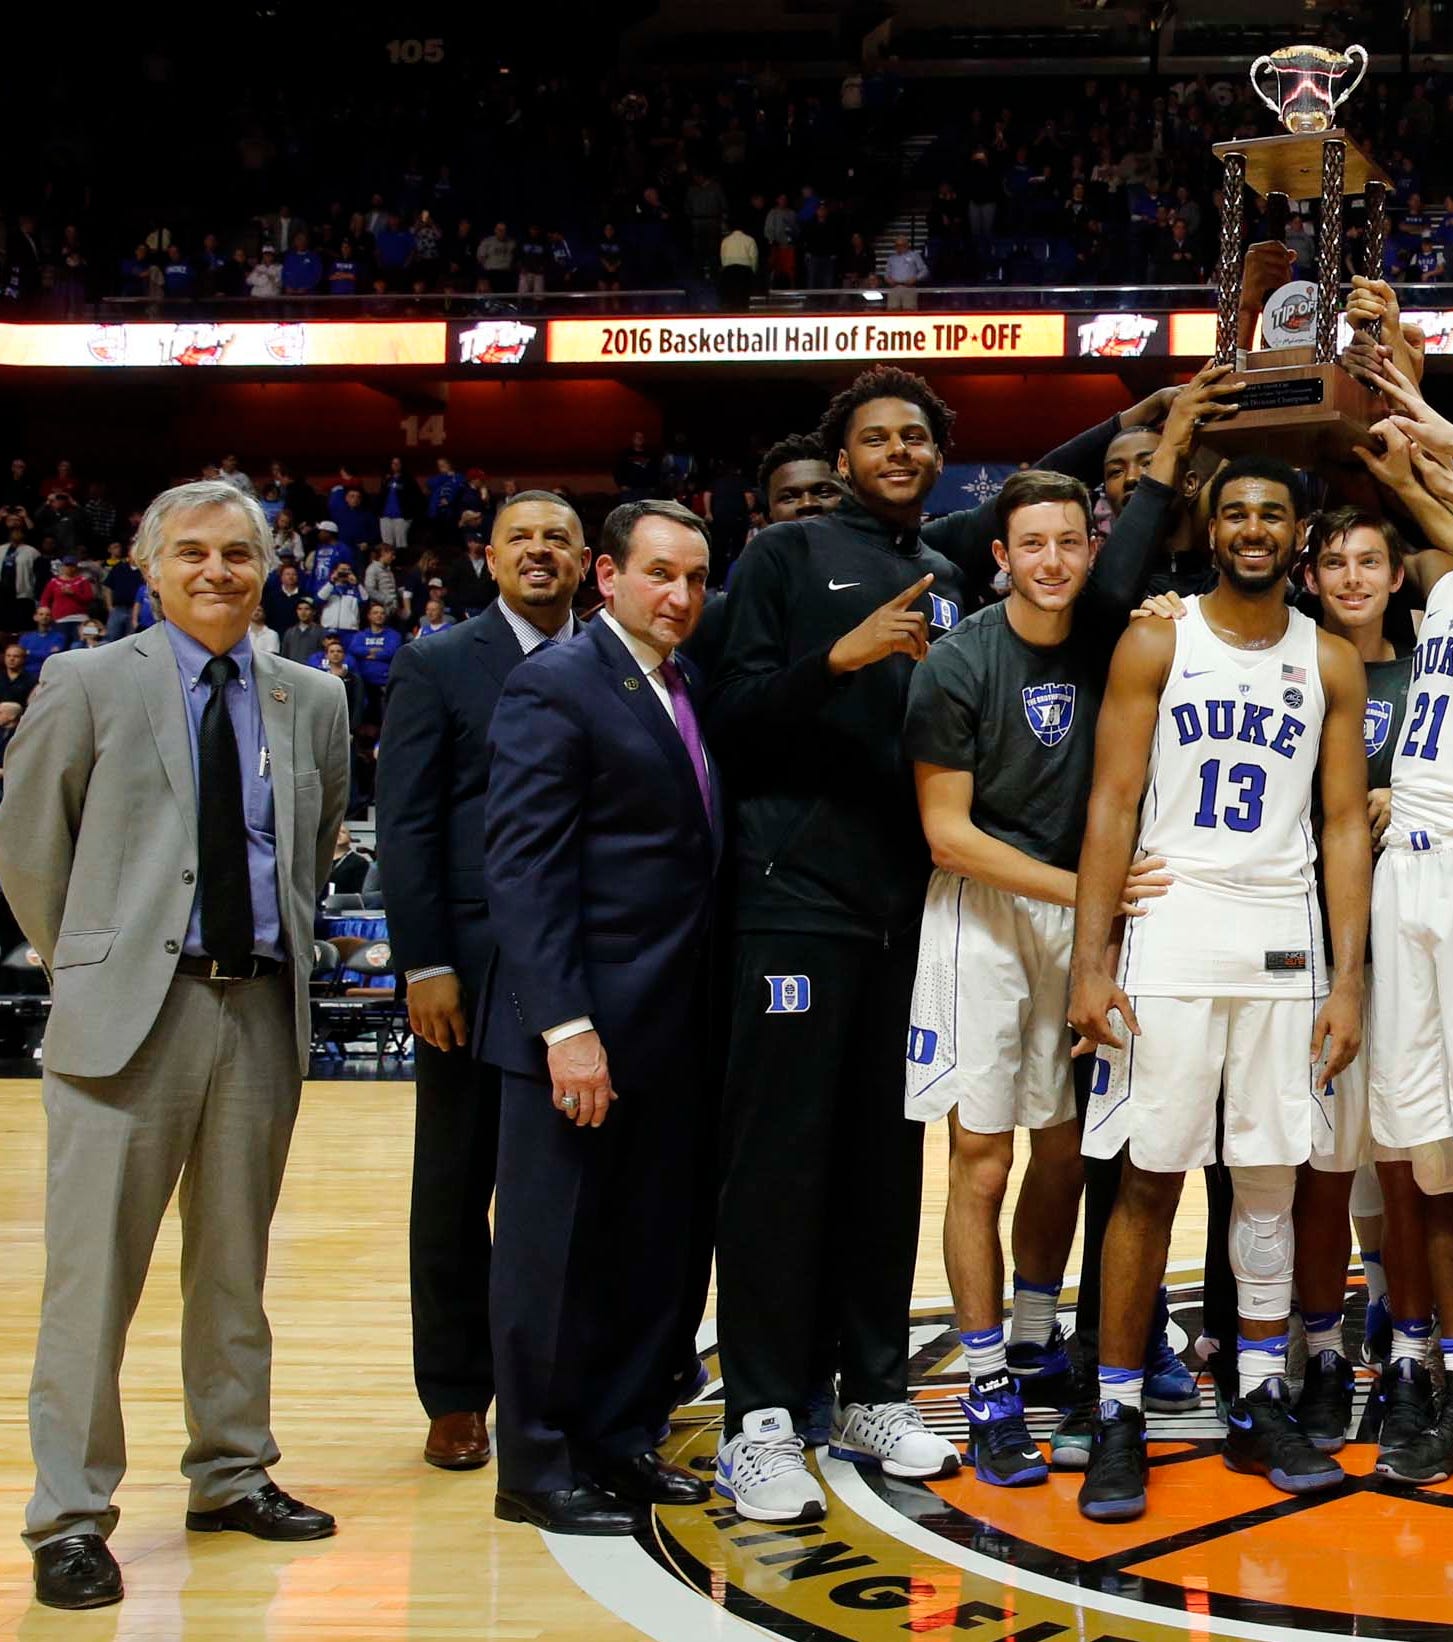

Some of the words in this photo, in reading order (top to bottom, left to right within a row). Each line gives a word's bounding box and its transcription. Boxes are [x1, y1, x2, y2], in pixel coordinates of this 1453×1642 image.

[386, 39, 444, 65] 105
[1271, 304, 1296, 330] TIP
[601, 328, 652, 355] 2016
[659, 327, 778, 353] Basketball
[785, 326, 829, 352] Hall
[835, 326, 859, 351] of
[865, 326, 926, 351] Fame
[400, 415, 446, 447] 14
[1170, 699, 1306, 760] DUKE
[1401, 692, 1451, 761] 21
[1193, 758, 1268, 834] 13
